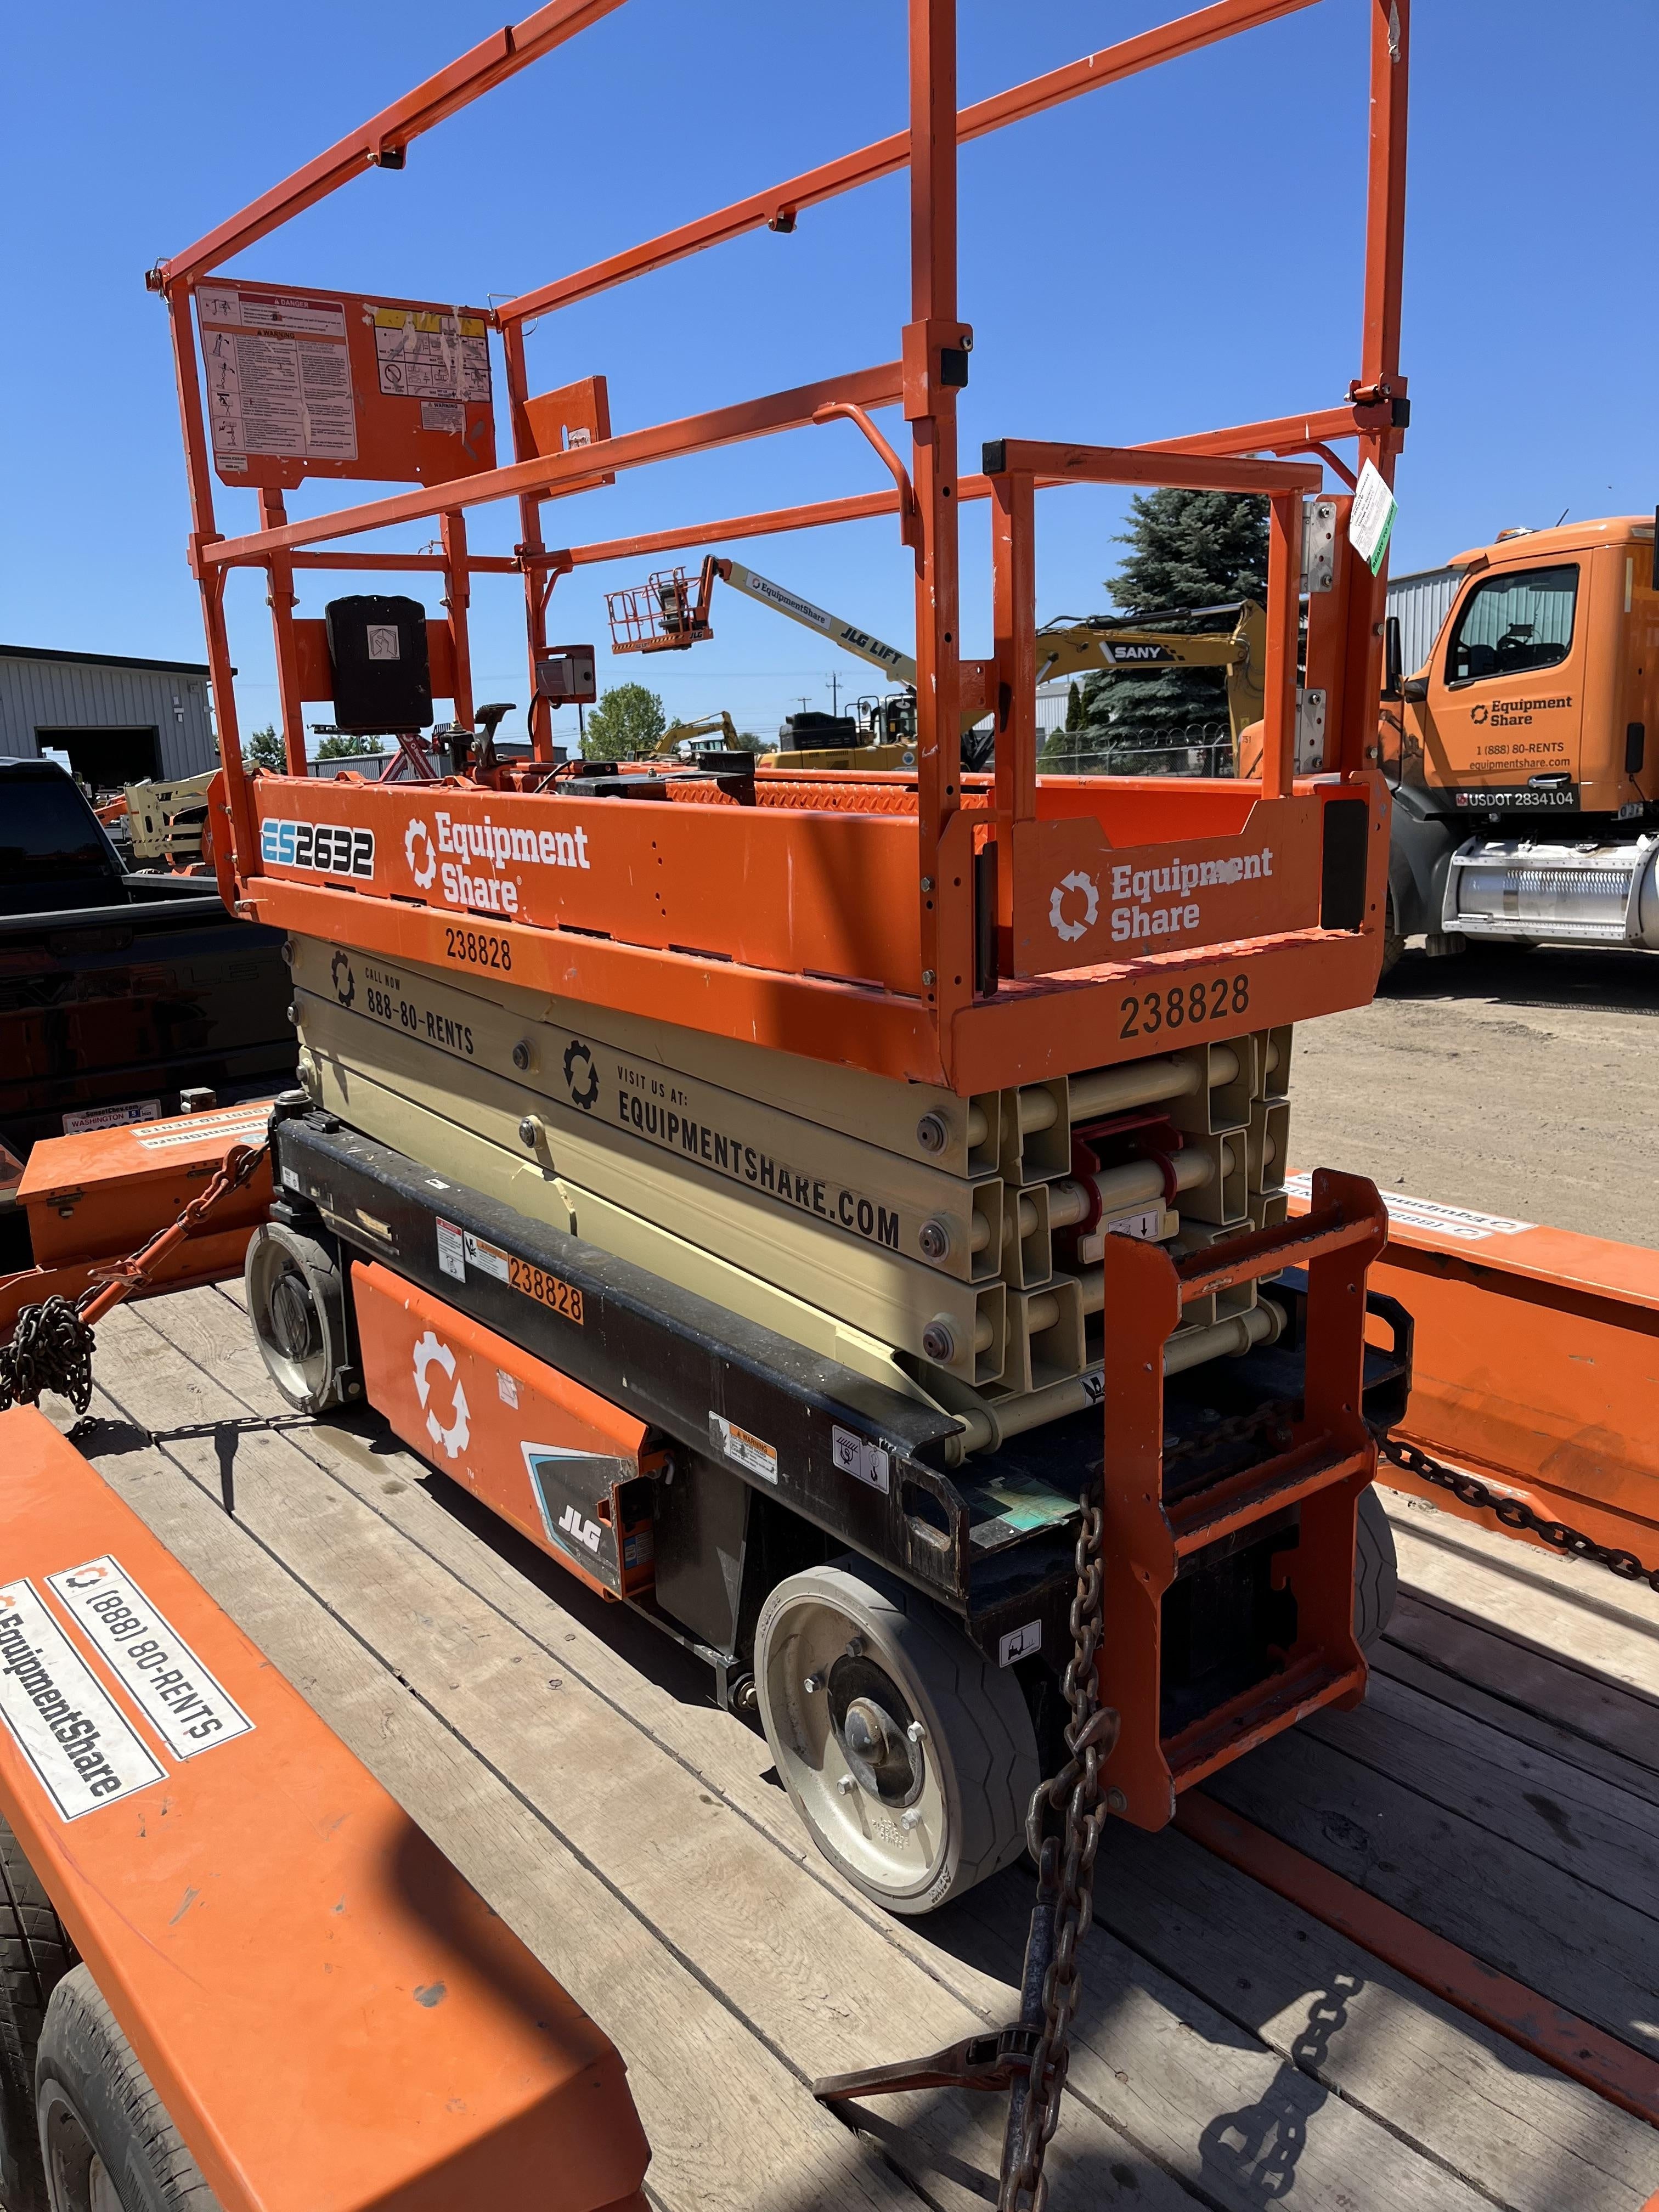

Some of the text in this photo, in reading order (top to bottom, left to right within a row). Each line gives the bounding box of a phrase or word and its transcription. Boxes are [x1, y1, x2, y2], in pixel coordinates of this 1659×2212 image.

[281, 300, 309, 308] DANGER
[263, 330, 295, 338] WARNING
[1372, 543, 1384, 569] READY
[1383, 528, 1388, 539] TO
[761, 583, 826, 624] EquipmentShare
[840, 627, 902, 665] JLG LIFT
[1114, 647, 1161, 659] SANY
[1490, 714, 1533, 726] Share
[1491, 696, 1573, 714] Equipment
[1469, 758, 1571, 771] equipmentshare.com
[1476, 742, 1565, 756] 1 (888) 80-RENTS
[1469, 791, 1574, 807] USDOT 2834104
[262, 820, 374, 879] ES2632
[435, 811, 590, 869] Equipment
[441, 863, 518, 912] Share
[1111, 903, 1200, 943] Share
[445, 927, 512, 972] 238828
[365, 967, 400, 991] CALL NOW
[368, 988, 474, 1055] 888-80-RENTS
[1119, 973, 1250, 1040] 238828
[617, 1065, 688, 1107] VISIT US AT:
[71, 1113, 125, 1127] WASHINGTON
[86, 1104, 138, 1118] SunsetChev.com
[618, 1089, 900, 1250] EQUIPMENTSHARE.COM
[510, 1257, 582, 1320] 238828
[743, 1433, 768, 1453] WARNING
[558, 1504, 602, 1553] JLG
[86, 1589, 223, 1739] (888) 80-RENTS
